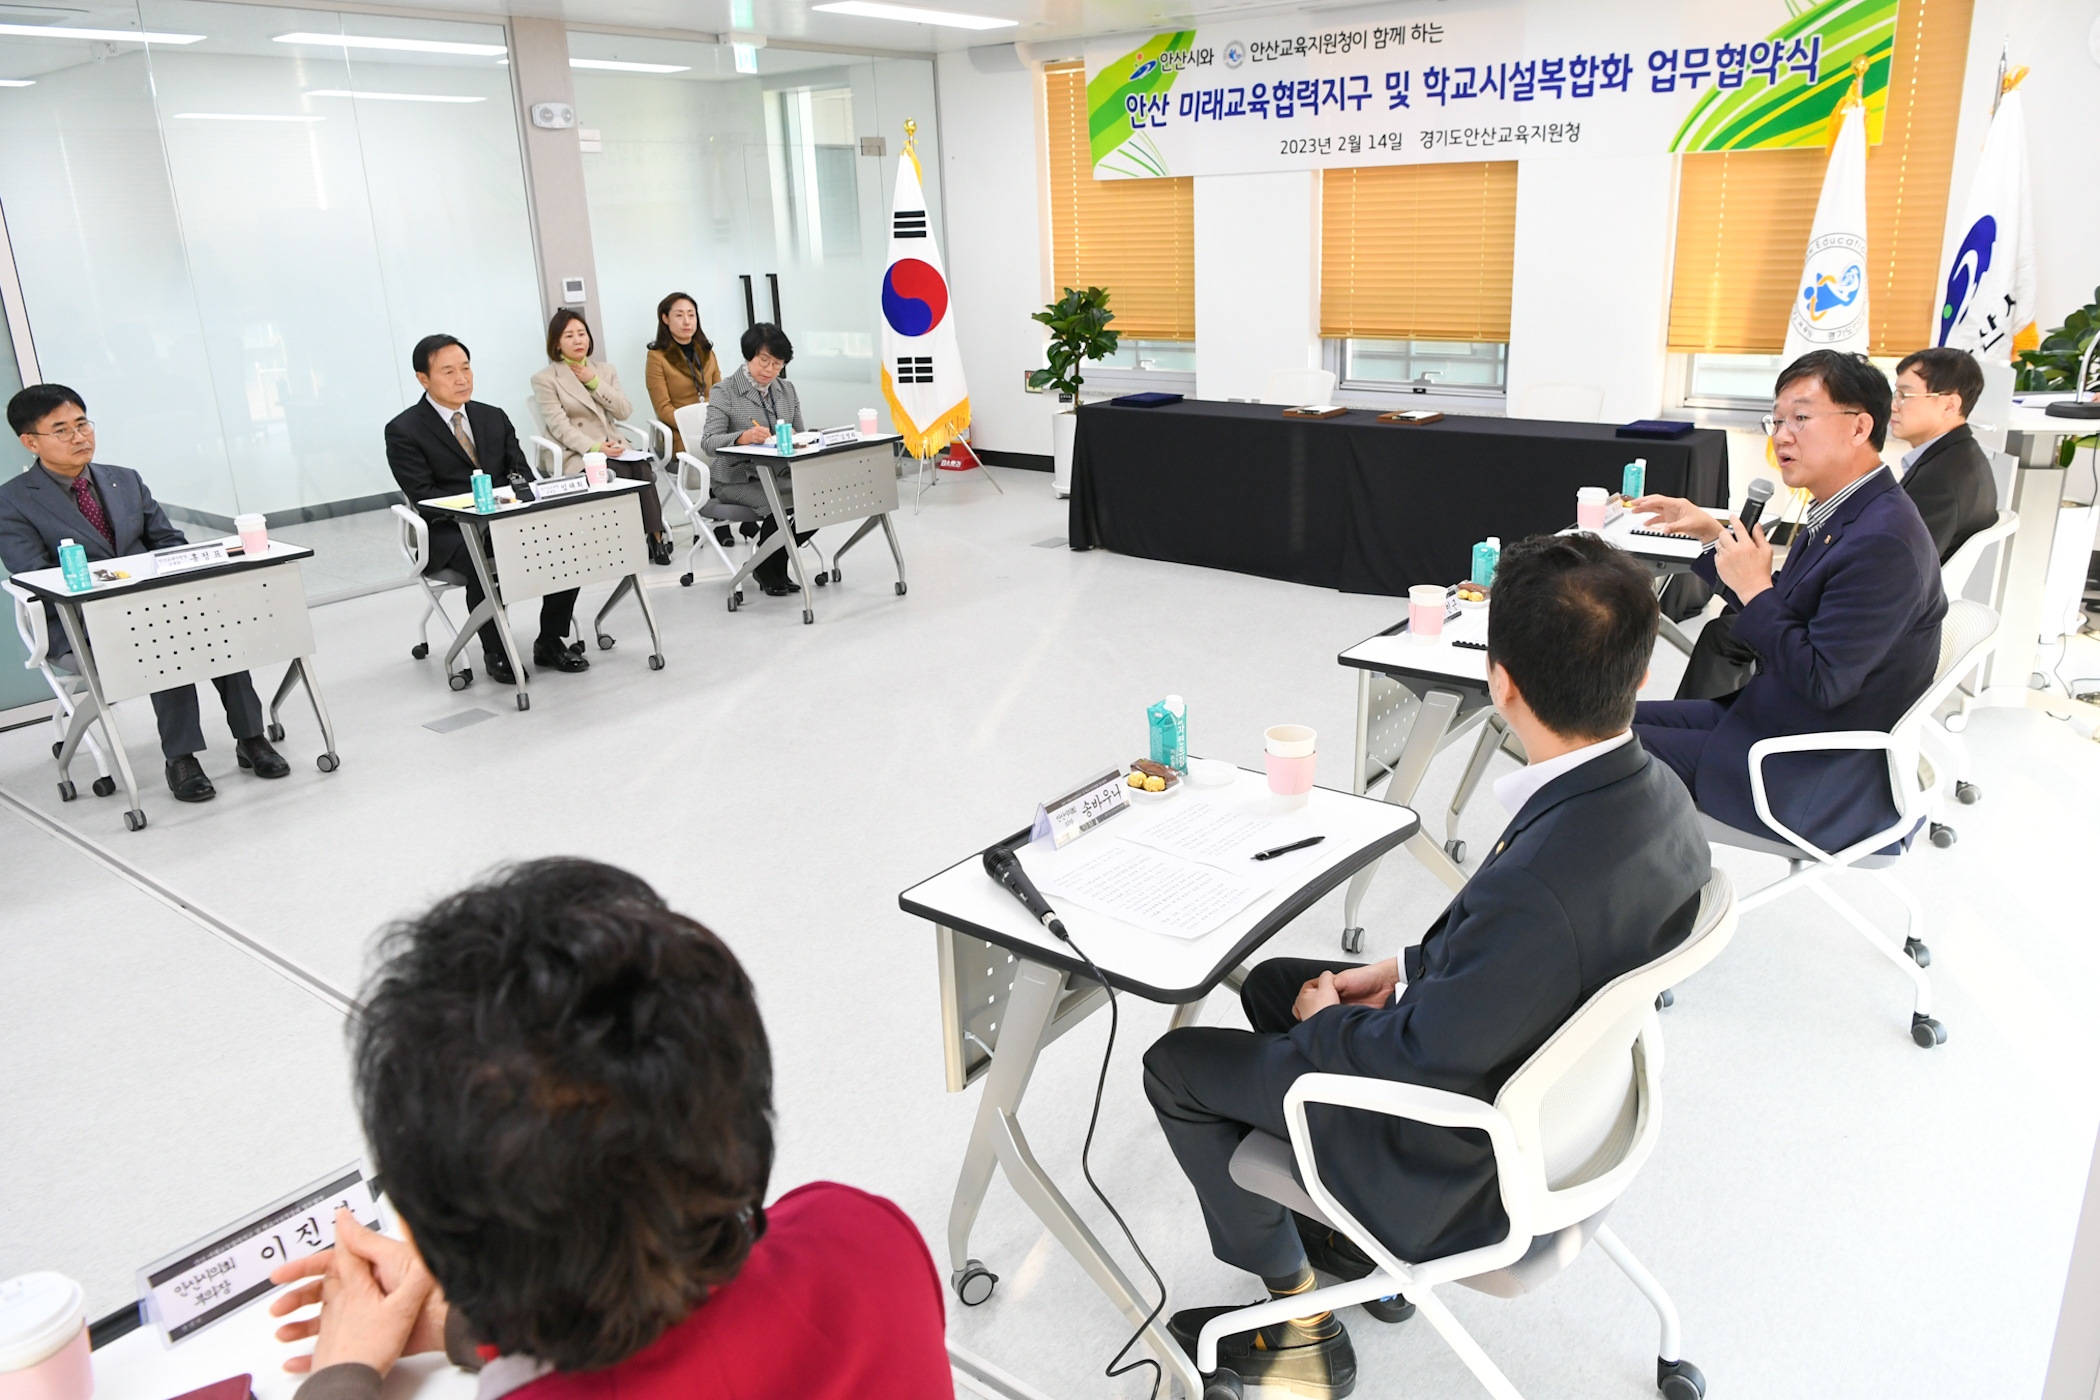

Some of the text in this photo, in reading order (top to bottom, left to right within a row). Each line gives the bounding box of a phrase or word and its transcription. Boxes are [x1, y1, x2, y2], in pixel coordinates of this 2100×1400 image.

[1160, 22, 1444, 71] 안산시와 안산교육지원청이 함께 하는
[1126, 36, 1820, 129] 안산 미래교육협력지구 및 학교시설복합화 업무협약식
[1280, 121, 1581, 155] 2023년 2월 14일 경기도안산교육지원청
[1082, 783, 1122, 818] 송바우나
[260, 1199, 356, 1263] 이진
[174, 1257, 236, 1297] 안산시의회
[194, 1280, 232, 1306] 부의장
